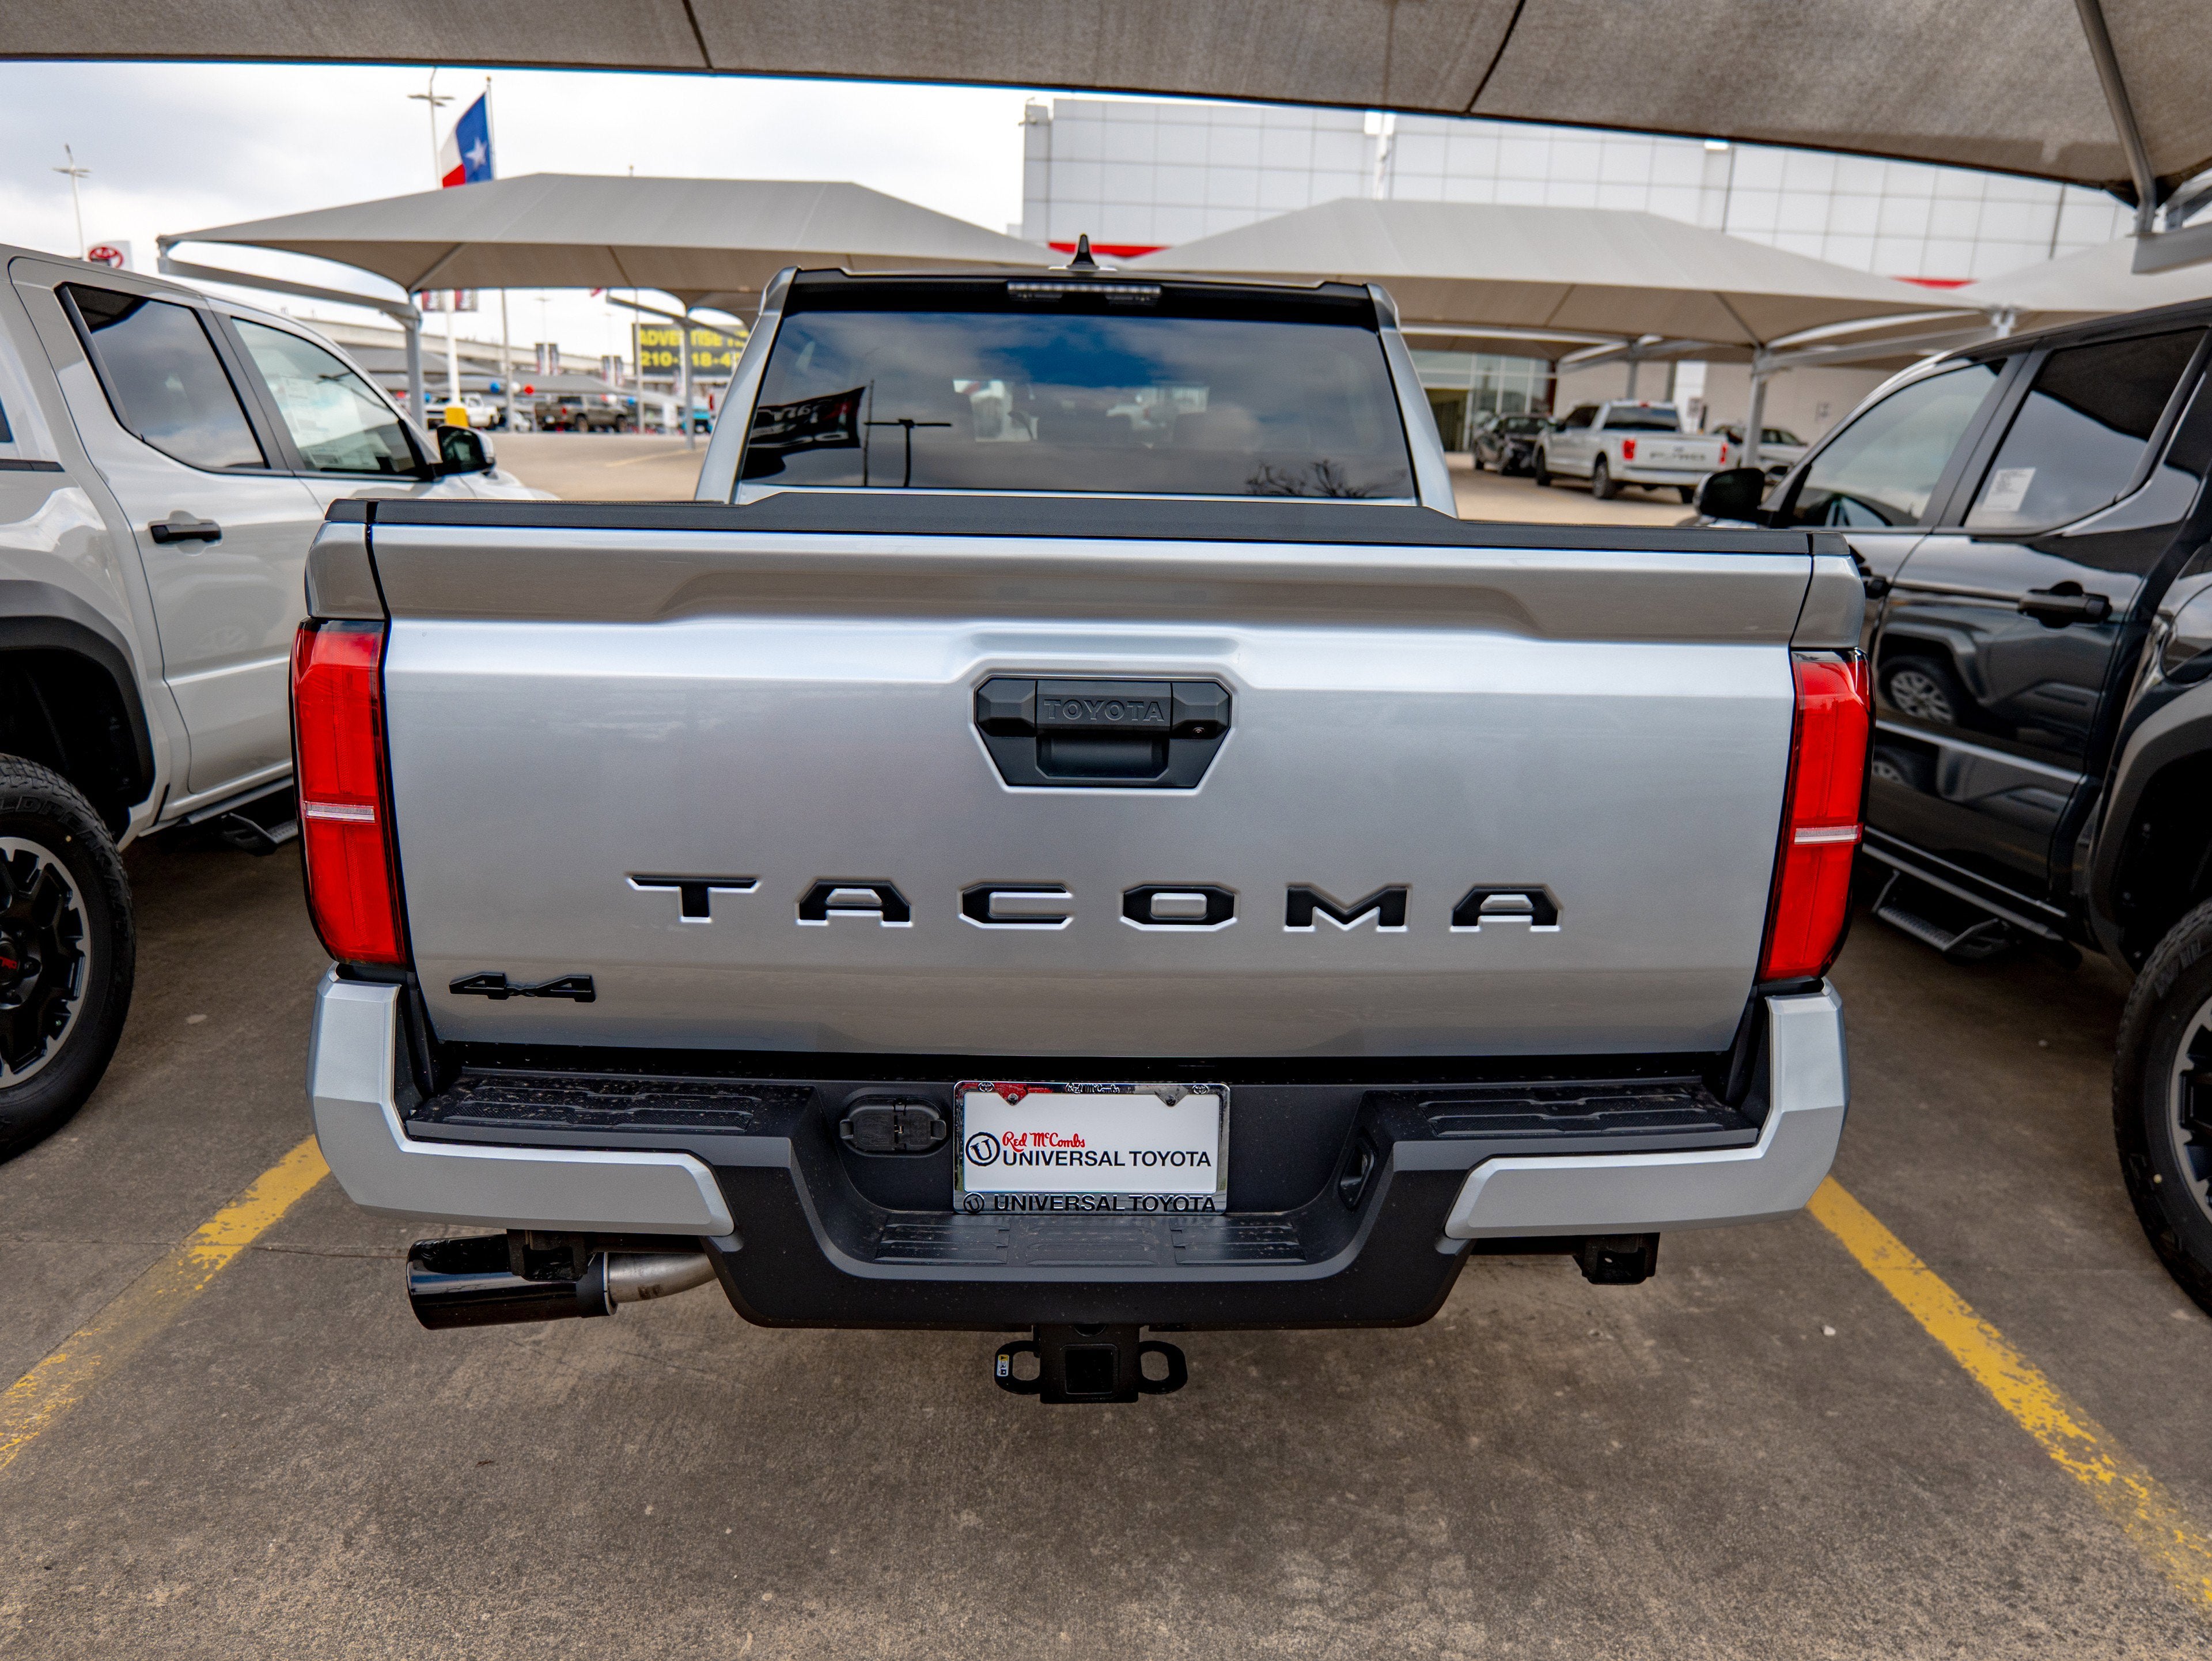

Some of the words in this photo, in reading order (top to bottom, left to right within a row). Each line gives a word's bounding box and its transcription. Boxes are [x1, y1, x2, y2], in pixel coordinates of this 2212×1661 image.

[639, 329, 722, 347] ADVETISE
[641, 351, 742, 368] 210-18-4
[1044, 699, 1165, 722] TOYOTA
[626, 873, 1562, 932] TACOMA
[1002, 1131, 1027, 1152] Red
[1029, 1132, 1085, 1148] McCombs
[1003, 1150, 1125, 1166] UNIVERSAL
[1129, 1151, 1211, 1167] TOYOTA
[994, 1194, 1125, 1212] UNIVERSAL
[1128, 1195, 1217, 1212] TOYOTA
